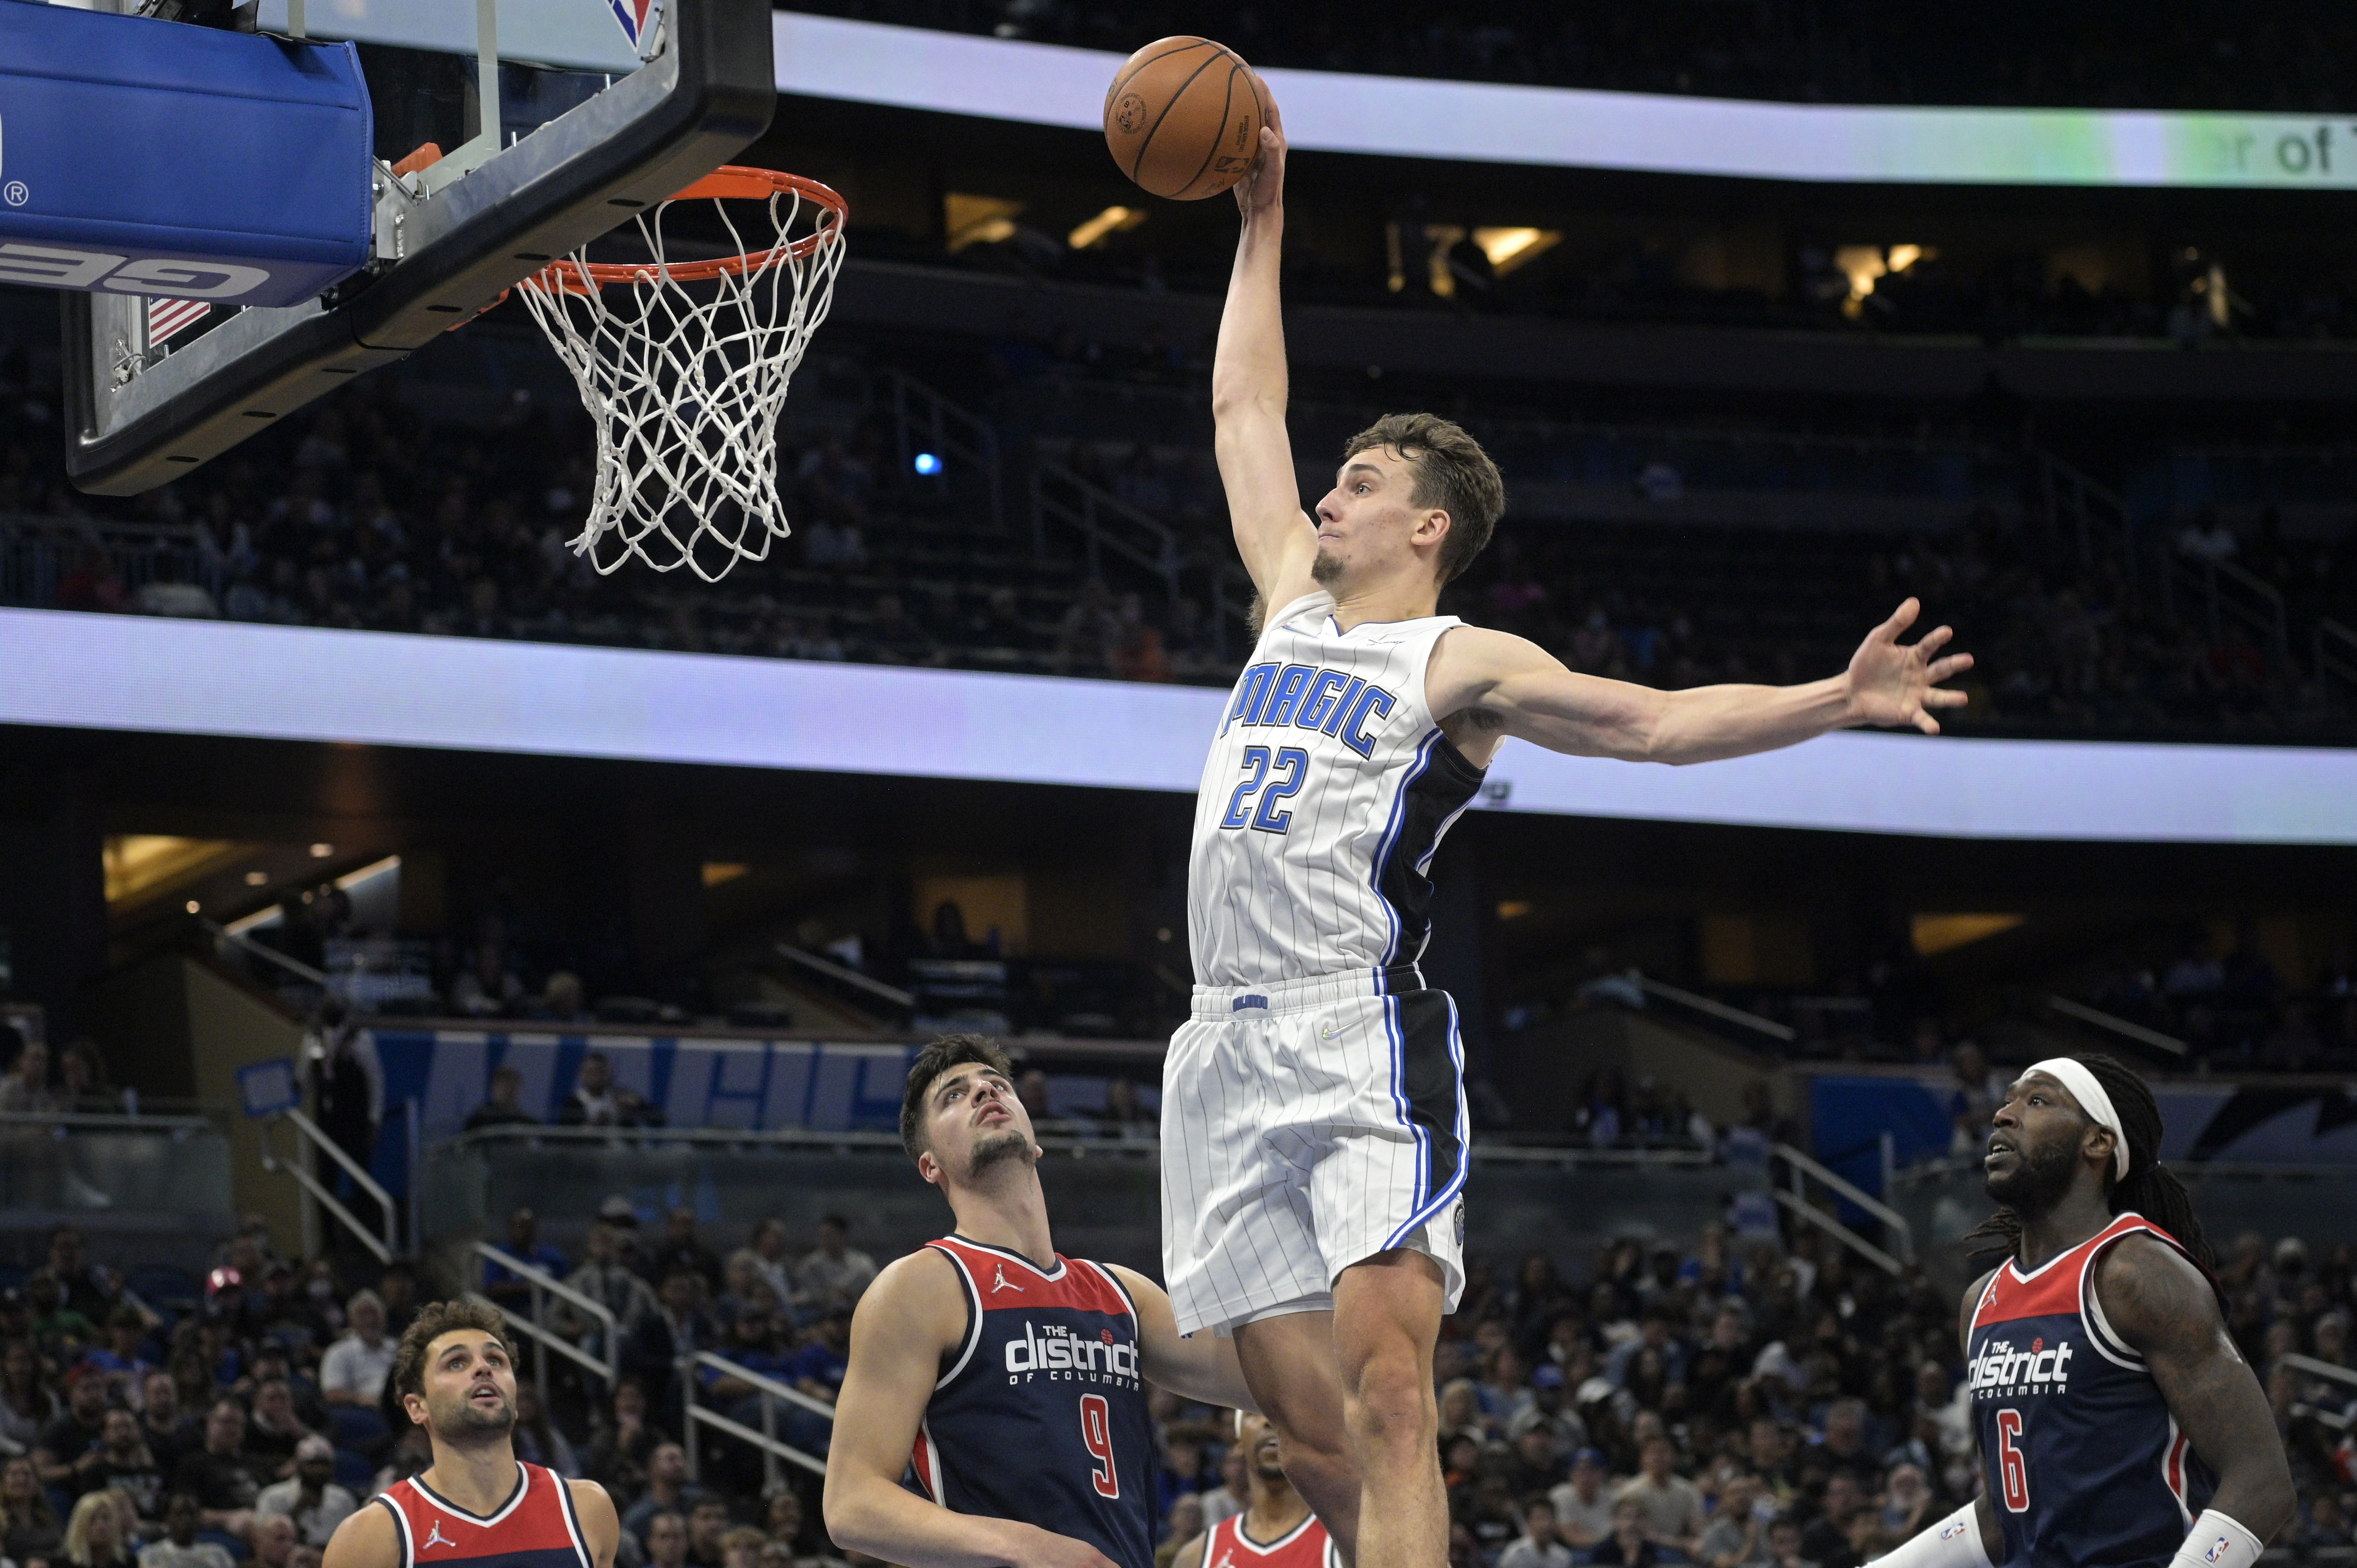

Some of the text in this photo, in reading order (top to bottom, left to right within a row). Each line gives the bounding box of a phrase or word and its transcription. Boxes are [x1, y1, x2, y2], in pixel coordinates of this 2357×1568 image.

[2275, 125, 2332, 176] of
[1220, 662, 1396, 761] MAGIC
[1220, 745, 1309, 835] 22
[1005, 1320, 1138, 1380] district
[1043, 1326, 1067, 1337] THE
[1992, 1341, 2009, 1354] THE
[1009, 1371, 1139, 1391] OF COLUMBIA
[1969, 1338, 2073, 1390] district
[1979, 1384, 2066, 1399] COLUMBIA
[1080, 1393, 1120, 1499] 9
[1997, 1409, 2030, 1513] 6
